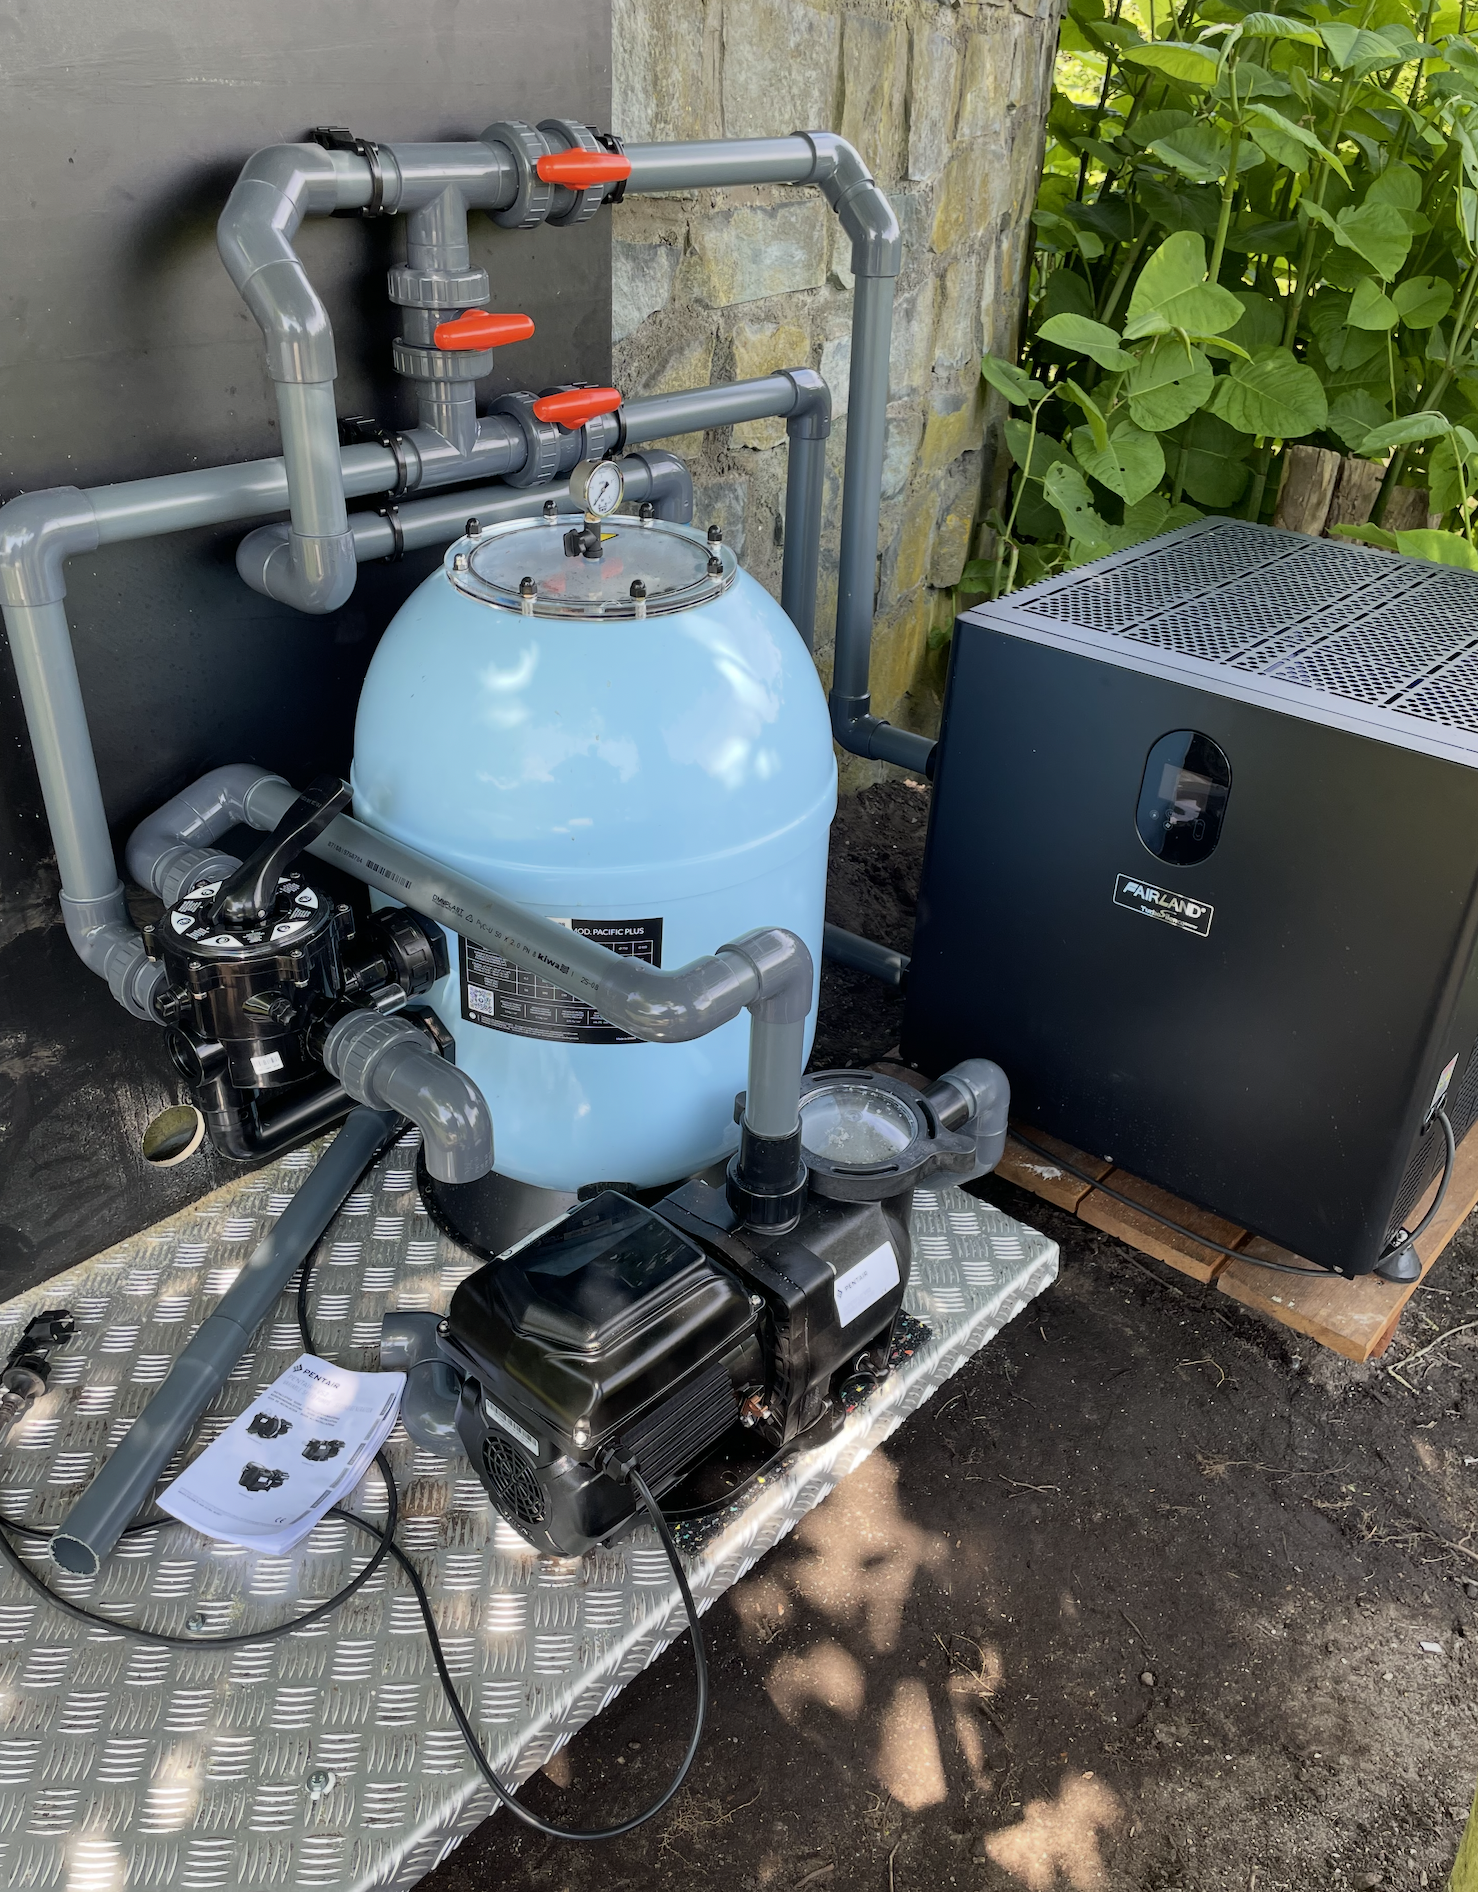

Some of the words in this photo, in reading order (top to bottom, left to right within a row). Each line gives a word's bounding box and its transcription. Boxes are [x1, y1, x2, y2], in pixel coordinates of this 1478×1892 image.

[1122, 881, 1203, 919] FAIRLAND
[593, 928, 624, 936] PACIFIC
[624, 927, 645, 936] PLUS
[476, 919, 494, 934] PVC-U
[494, 930, 502, 939] 50
[509, 939, 521, 949] 2.0
[522, 945, 531, 955] PN
[538, 953, 560, 971] kiwa
[844, 1271, 868, 1291] PENTAIR
[302, 1368, 341, 1389] PENTAIR
